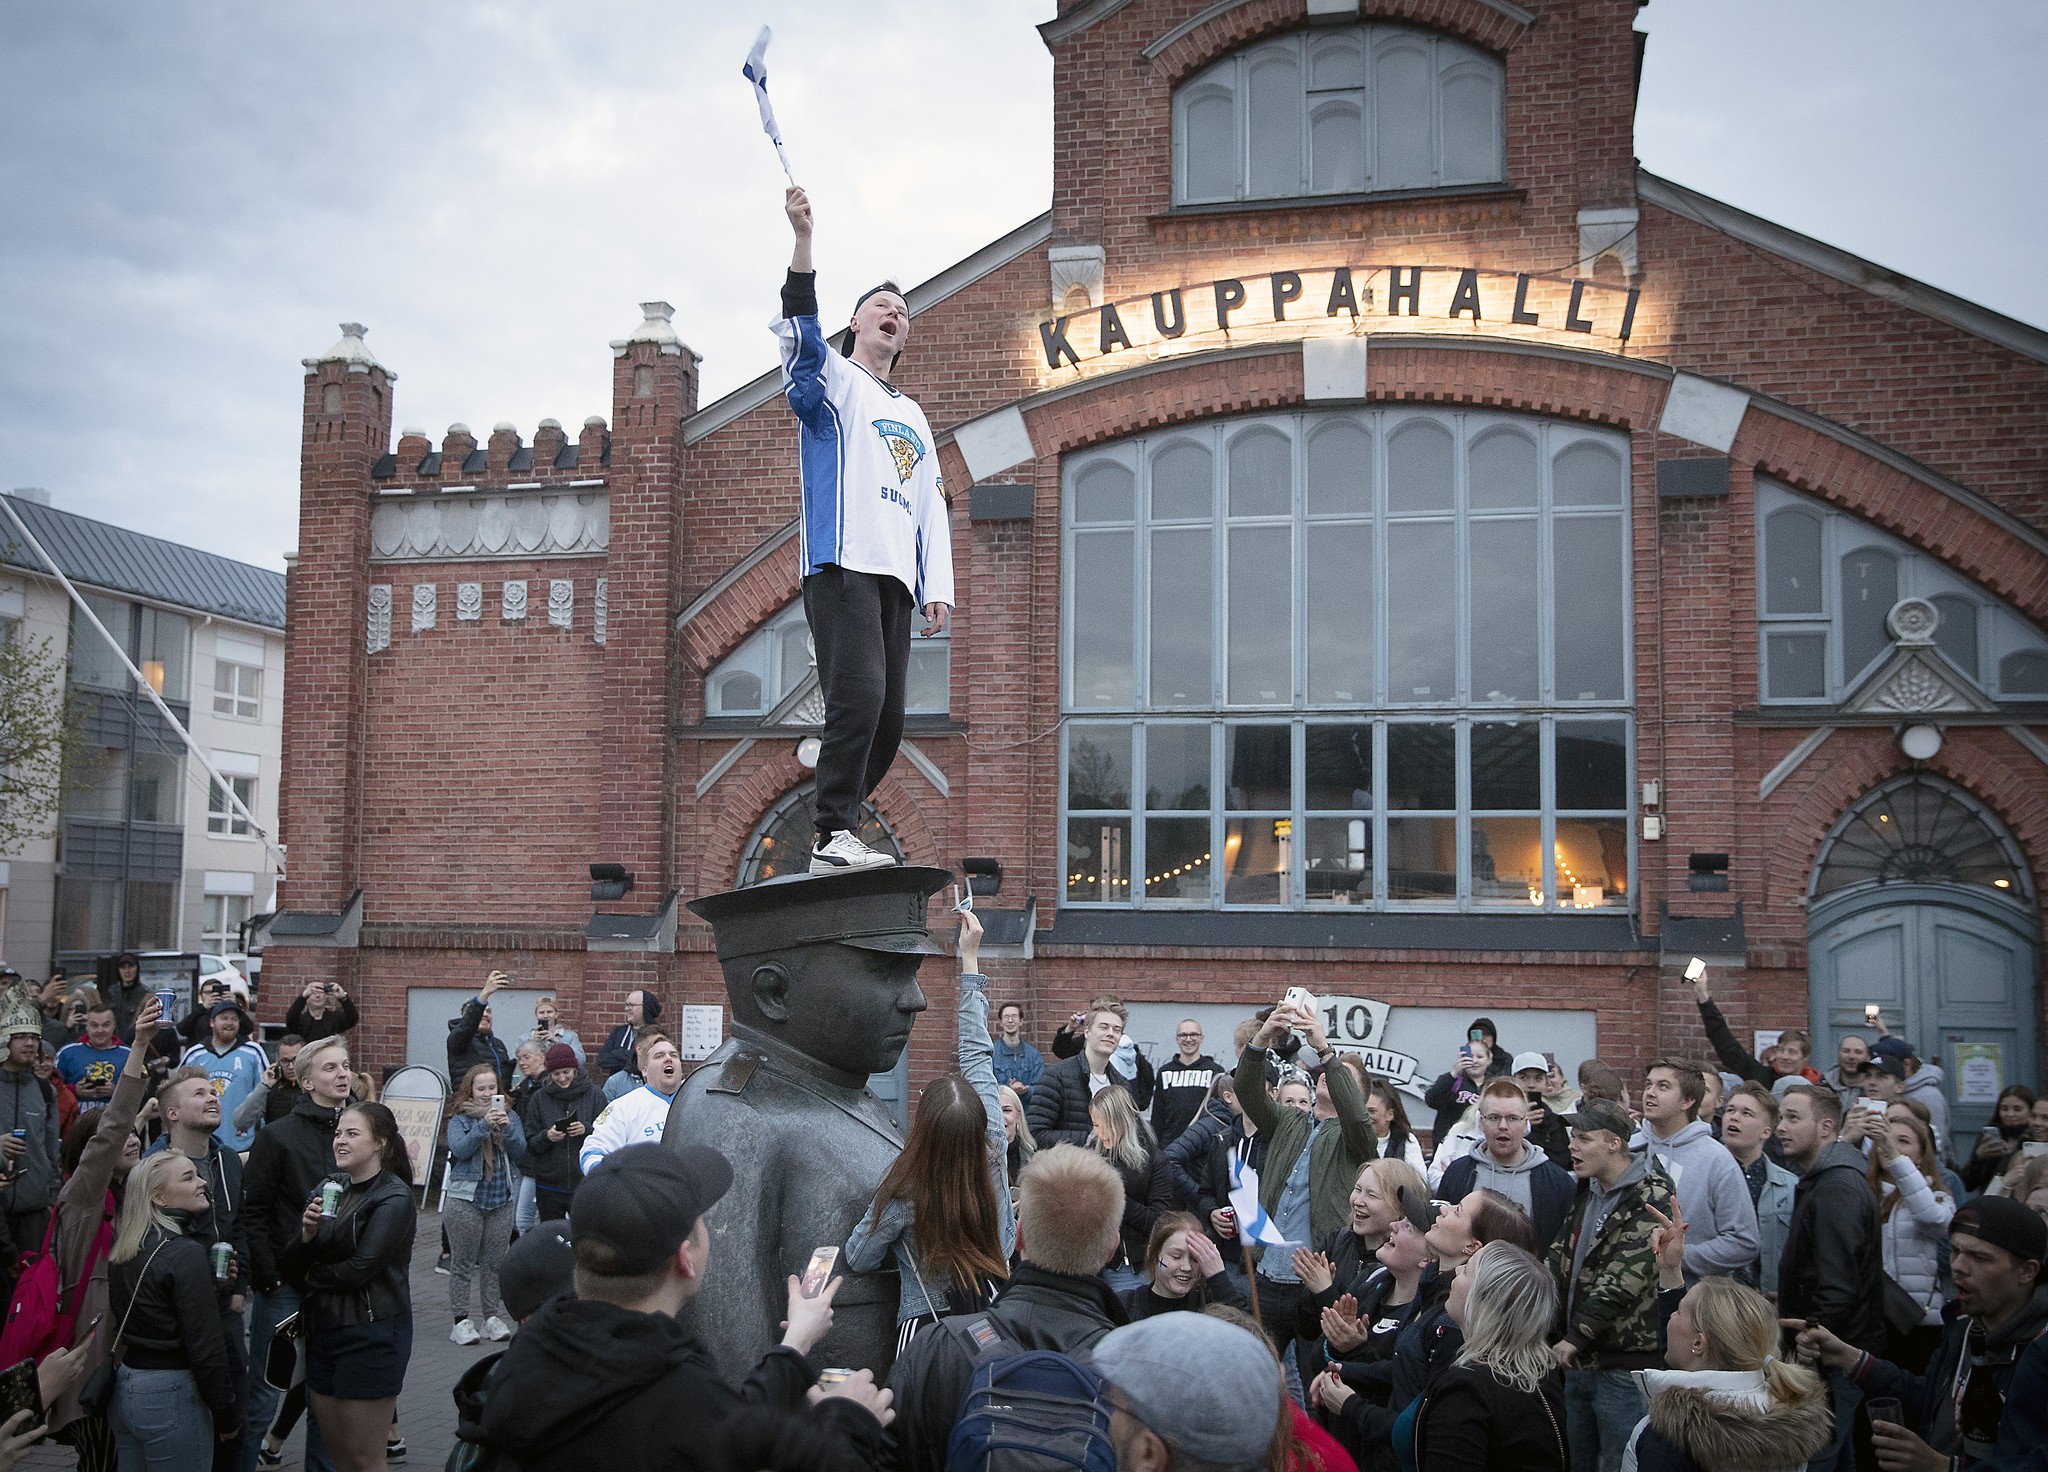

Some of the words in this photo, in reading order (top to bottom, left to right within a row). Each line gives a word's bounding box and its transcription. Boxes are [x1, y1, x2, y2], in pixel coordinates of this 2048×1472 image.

[1039, 266, 1640, 368] KAUPPAHALLI
[881, 422, 922, 449] FINLAND
[1322, 1004, 1373, 1041] 10
[233, 1056, 243, 1070] A
[1356, 1050, 1404, 1075] ALLI
[209, 1070, 233, 1079] UOMI
[1161, 1070, 1213, 1090] PUMA
[643, 1121, 665, 1137] SU
